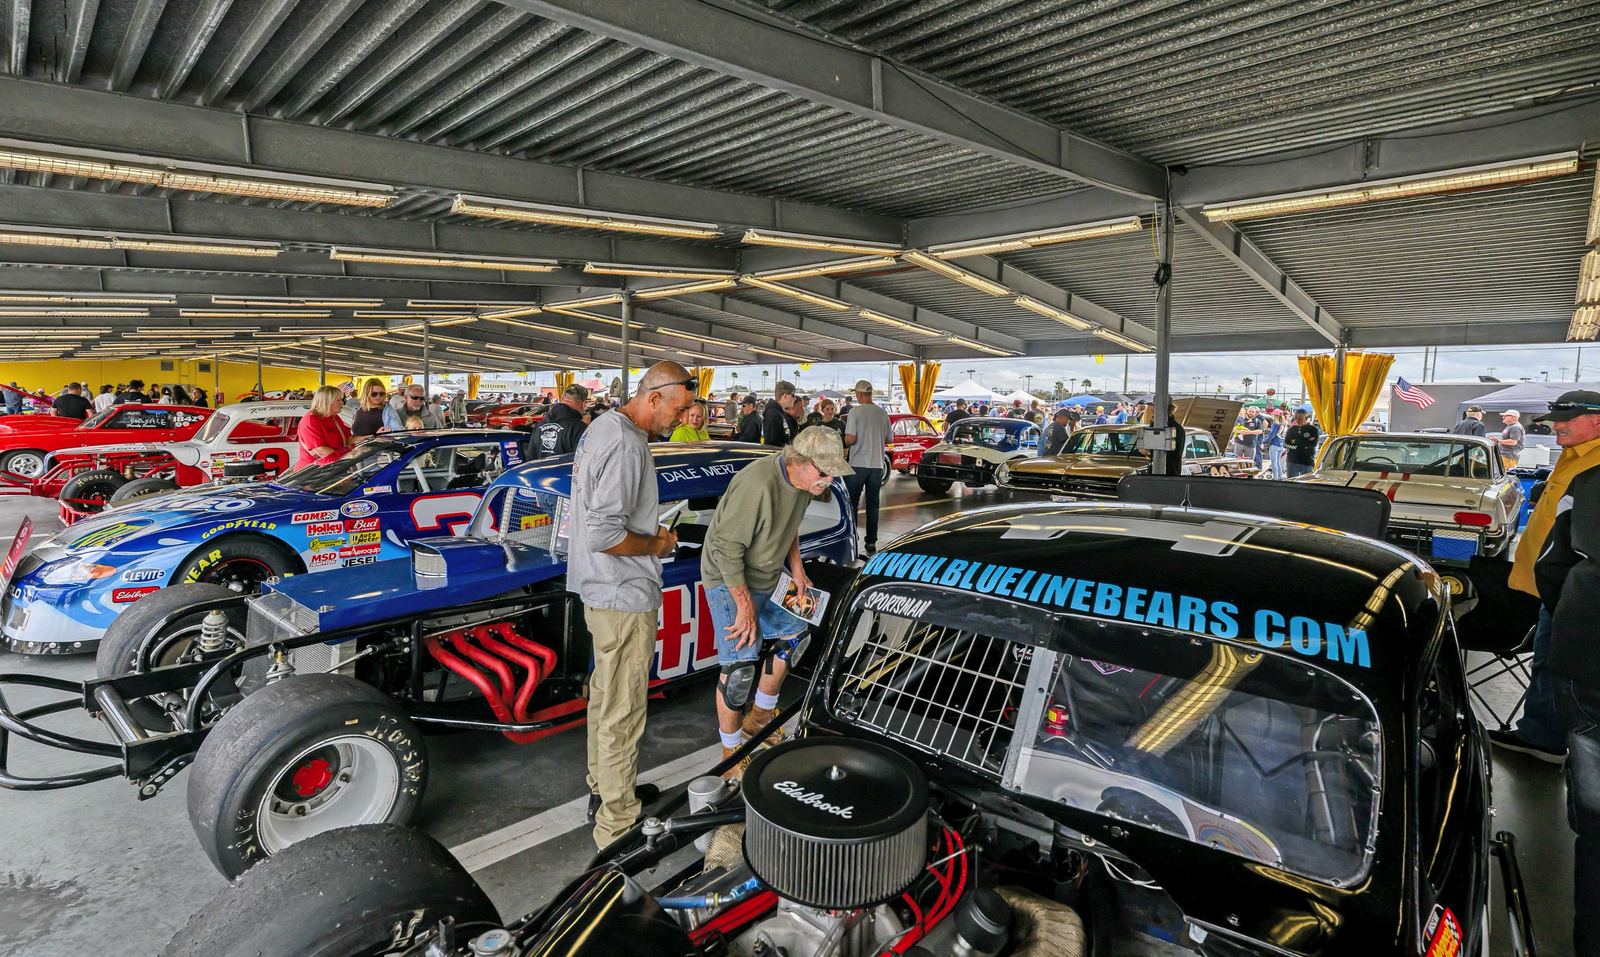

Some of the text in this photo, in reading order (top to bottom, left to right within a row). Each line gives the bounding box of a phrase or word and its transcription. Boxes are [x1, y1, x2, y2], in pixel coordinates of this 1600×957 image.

[252, 448, 289, 480] 9
[661, 464, 740, 483] DALE MERZ
[294, 512, 328, 521] COMP
[354, 519, 379, 529] Bud
[202, 519, 276, 539] GOODYEAR
[308, 524, 343, 535] Holley
[352, 545, 380, 555] Aeroquip
[312, 553, 336, 563] MSD
[116, 590, 155, 599] Edelbro
[864, 591, 931, 618] SPORTSMAN
[1254, 609, 1371, 668] COM
[773, 780, 853, 820] Edelbrock
